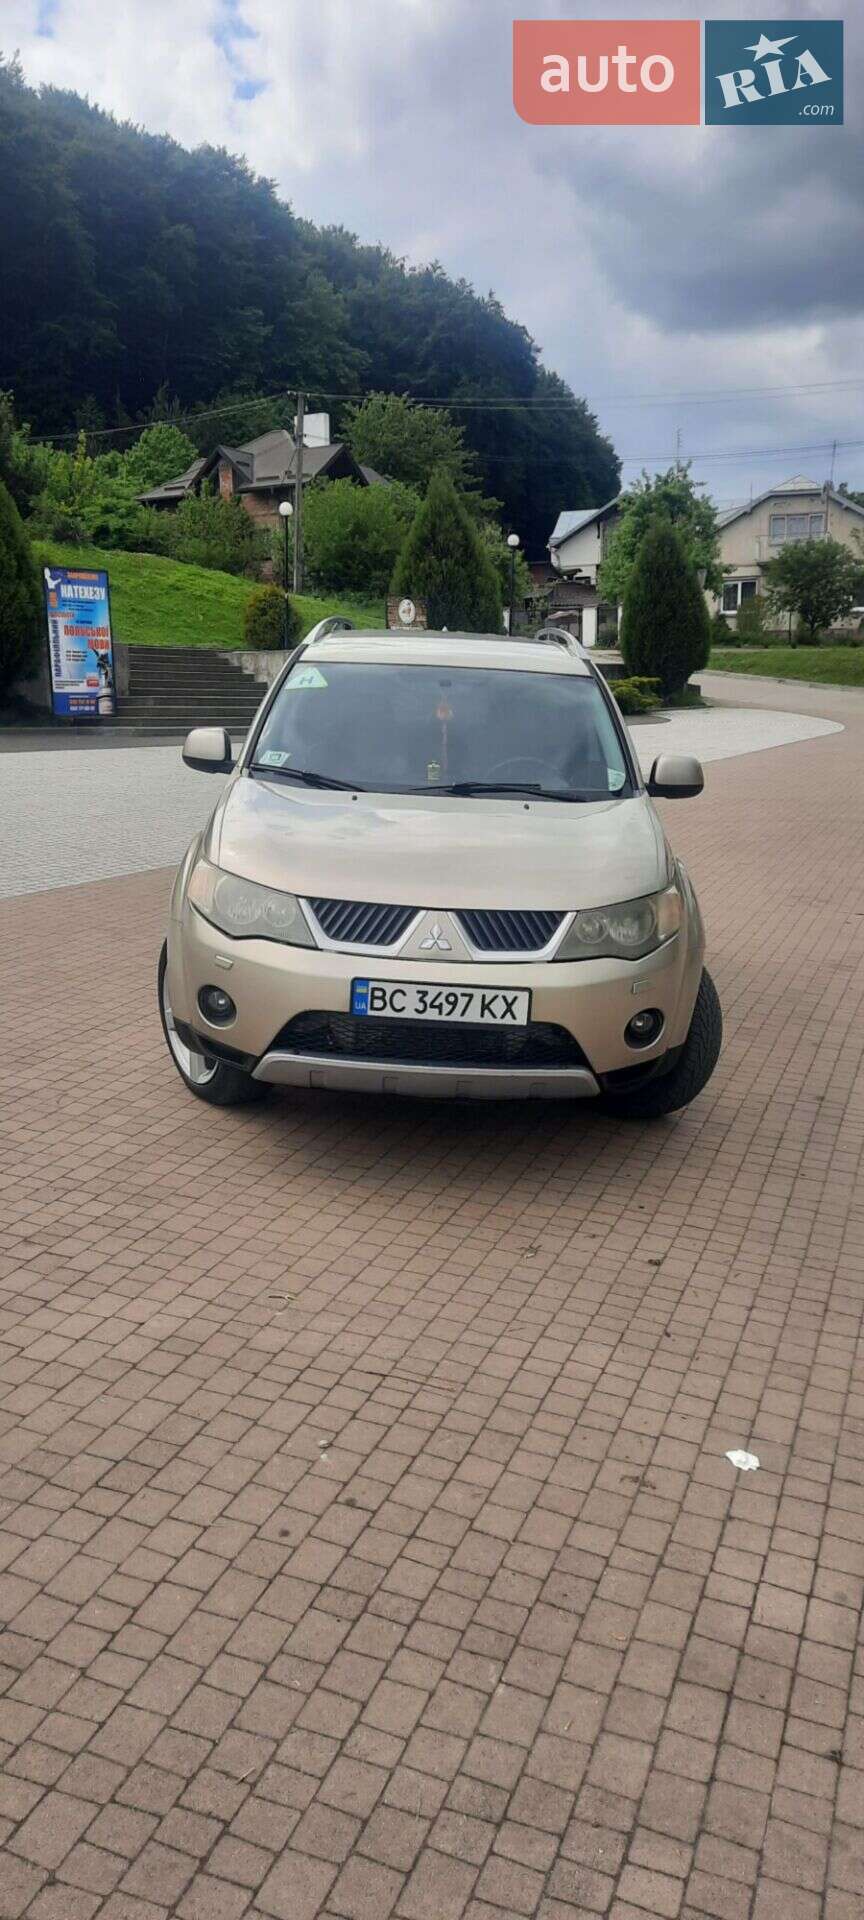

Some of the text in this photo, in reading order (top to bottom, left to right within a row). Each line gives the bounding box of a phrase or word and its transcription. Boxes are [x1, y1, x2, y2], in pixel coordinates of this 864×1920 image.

[355, 1001, 367, 1010] UA
[369, 986, 519, 1020] BC 3497 KX
